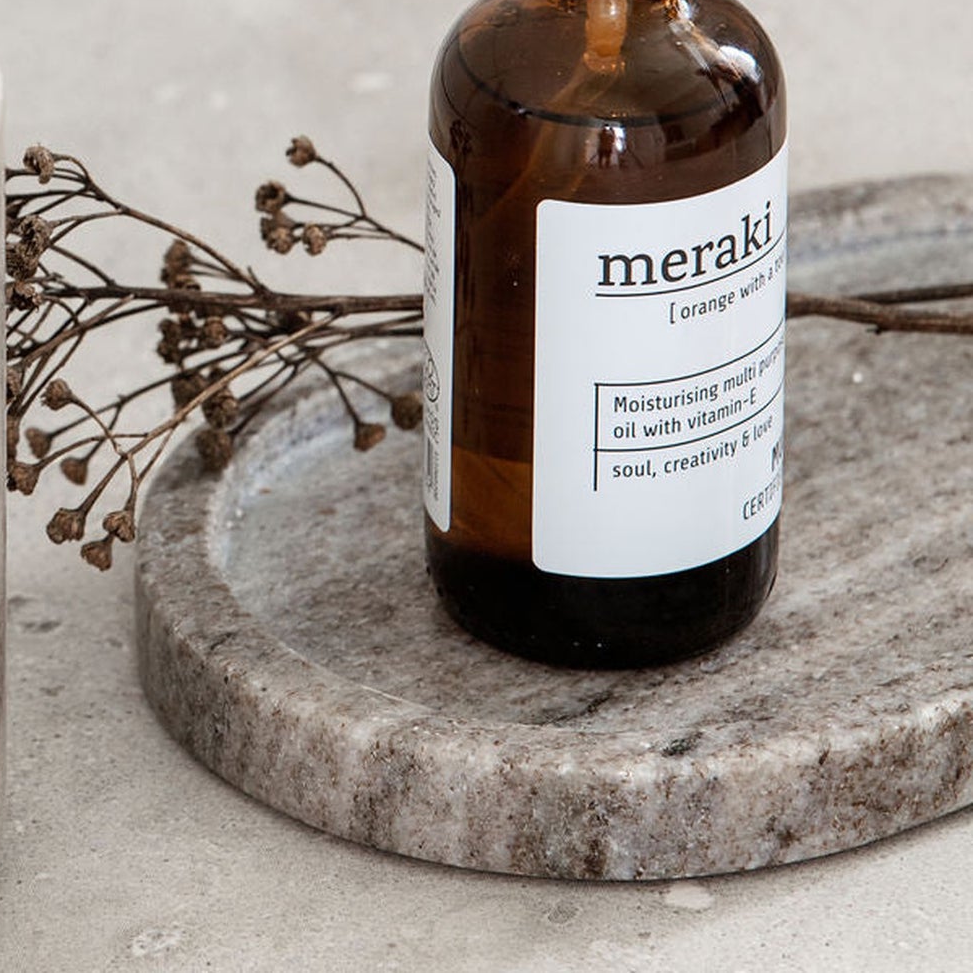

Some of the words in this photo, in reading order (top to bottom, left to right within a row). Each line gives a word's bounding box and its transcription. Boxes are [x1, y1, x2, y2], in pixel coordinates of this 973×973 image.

[598, 201, 772, 286] meraki
[739, 275, 766, 299] with
[613, 422, 636, 439] oil
[643, 417, 682, 437] with
[687, 387, 757, 429] vitamin-E
[614, 384, 719, 413] Moisturising
[723, 362, 757, 394] multi
[612, 460, 656, 478] soul,
[664, 439, 738, 474] creativity
[742, 429, 750, 448] &
[753, 416, 773, 439] love
